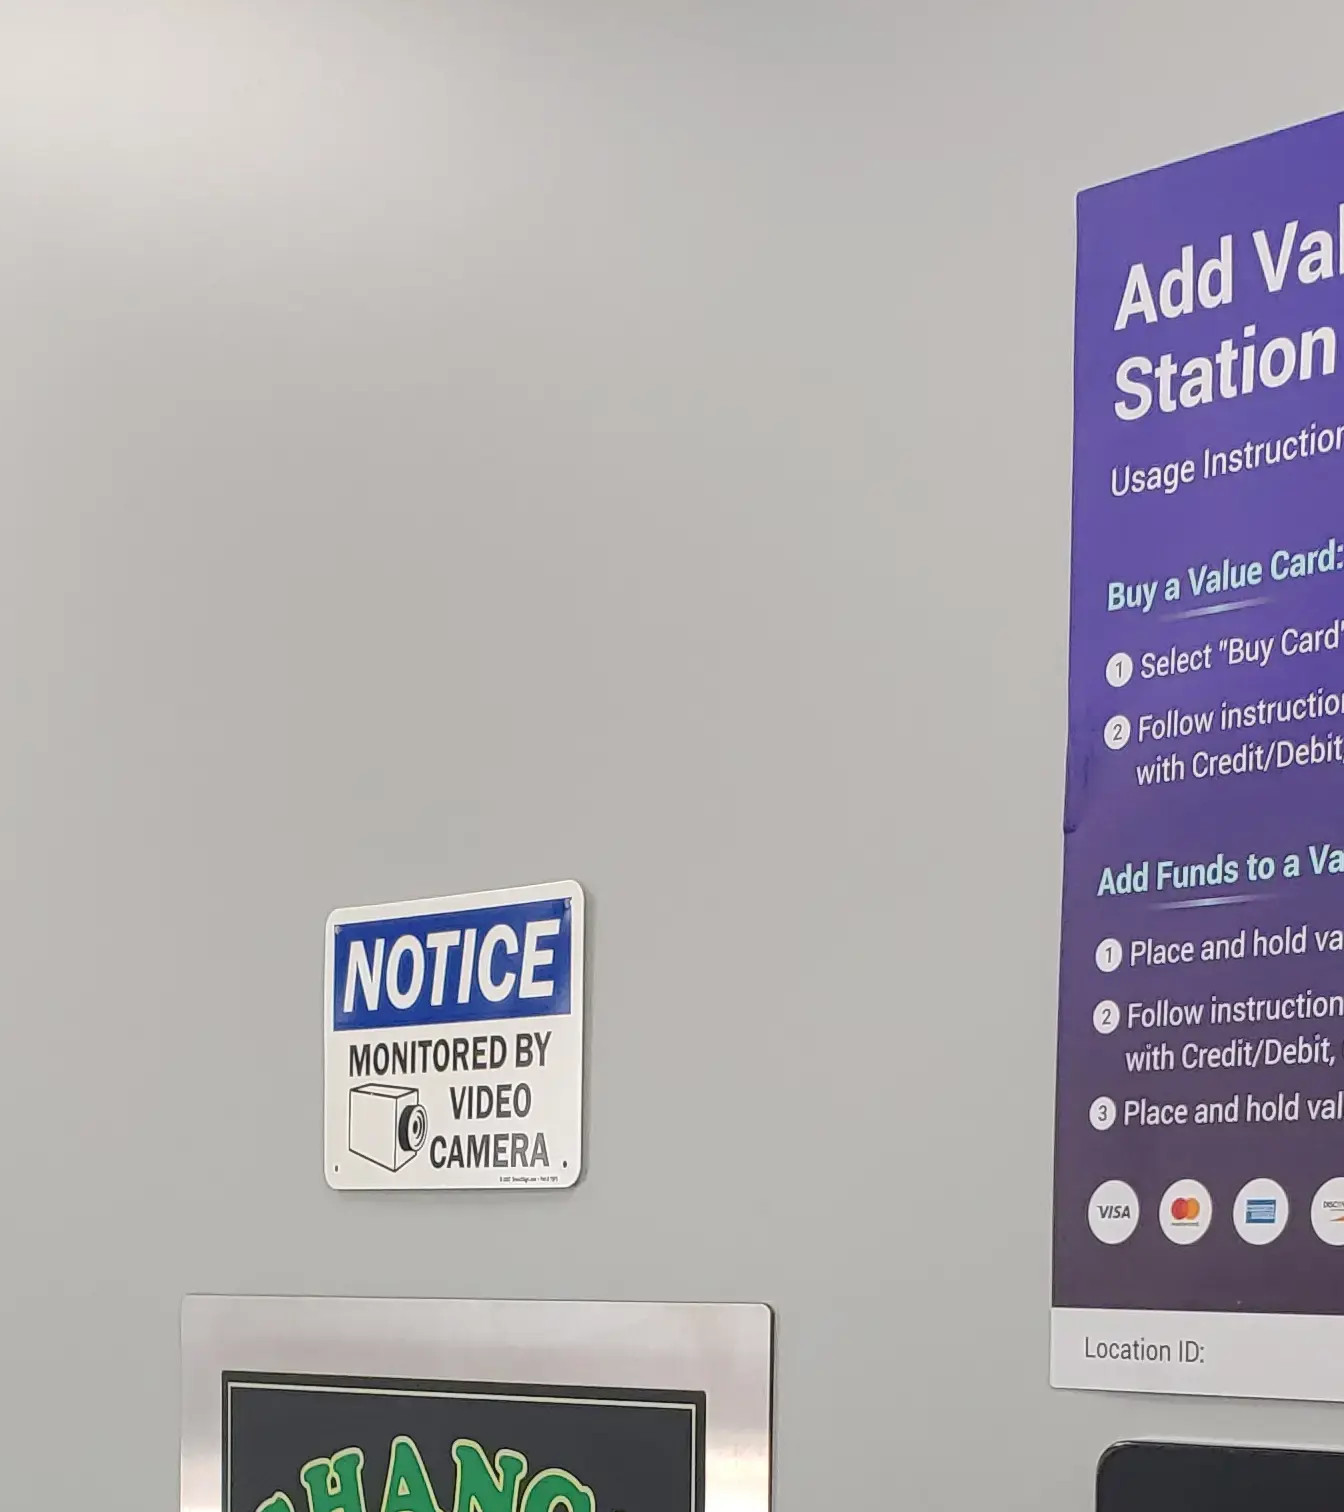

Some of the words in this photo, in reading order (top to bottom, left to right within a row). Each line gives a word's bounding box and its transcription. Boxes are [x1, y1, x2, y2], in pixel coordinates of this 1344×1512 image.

[1113, 235, 1232, 330] Add
[1112, 326, 1337, 422] Station
[1111, 456, 1195, 498] Usage
[1107, 577, 1155, 613] Buy
[1164, 576, 1181, 602] a
[1188, 558, 1262, 599] Value
[1271, 540, 1344, 584] Card:
[1141, 642, 1211, 681] Select
[1220, 632, 1273, 668] "Buy
[1138, 705, 1213, 744] Follow
[1137, 748, 1185, 786] with
[1098, 860, 1149, 896] Add
[1156, 854, 1238, 891] Funds
[1247, 852, 1275, 882] to
[1283, 853, 1301, 878] a
[343, 919, 561, 1013] NOTICE
[1130, 933, 1193, 968] Place
[1201, 931, 1246, 962] and
[1254, 923, 1306, 959] hold
[1127, 995, 1203, 1030] Follow
[349, 1035, 507, 1077] MONITORED
[515, 1031, 552, 1068] BY
[1125, 1039, 1173, 1073] with
[1181, 1030, 1335, 1069] Credit/Debit,
[450, 1083, 531, 1119] VIDEO
[430, 1133, 549, 1168] CAMERA
[1097, 1205, 1130, 1218] VISA
[1085, 1336, 1171, 1362] Location
[1179, 1340, 1205, 1364] ID:
